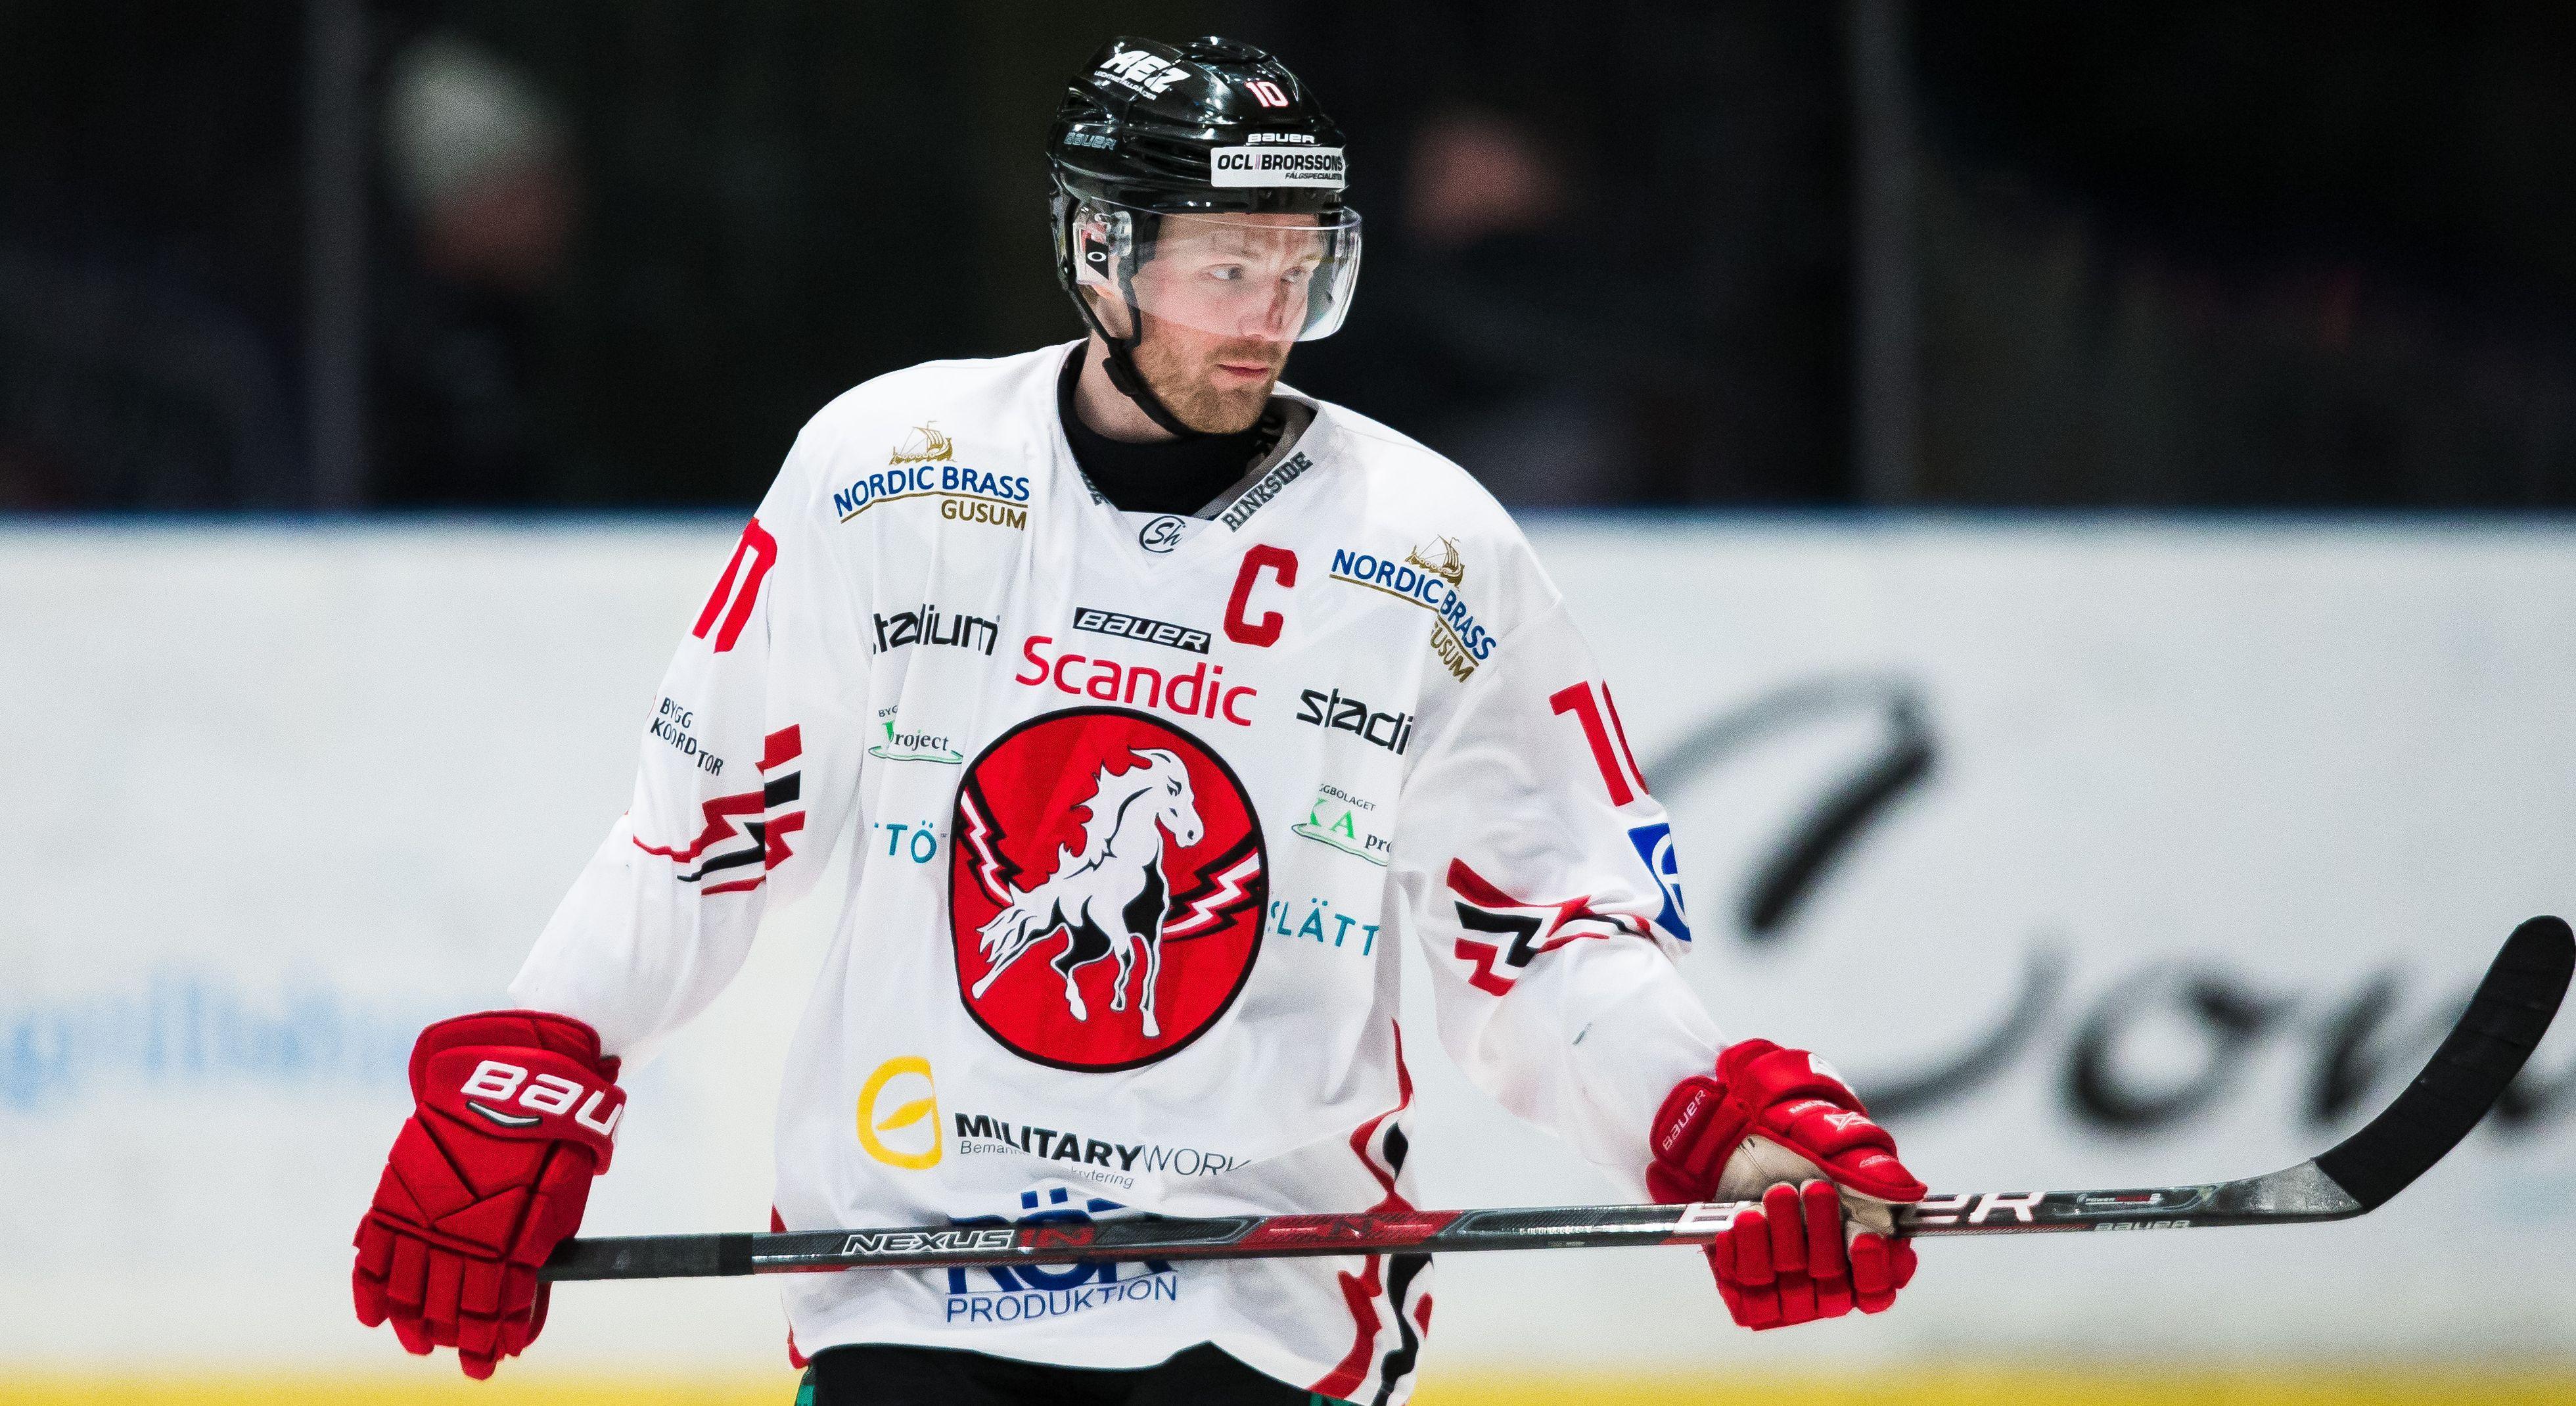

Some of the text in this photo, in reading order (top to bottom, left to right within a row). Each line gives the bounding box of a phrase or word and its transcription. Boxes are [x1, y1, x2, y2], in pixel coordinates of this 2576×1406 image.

[1243, 81, 1289, 107] 10
[1248, 133, 1315, 144] BAUER
[1217, 154, 1343, 172] OCL BRORSSONS
[833, 466, 934, 517] NORDIC
[942, 466, 1030, 502] BRASS
[941, 500, 1027, 531] GUSUM
[1221, 451, 1314, 533] RINKSIDE
[1223, 544, 1299, 648] C
[1331, 548, 1496, 660] NORDIC BRASS
[1076, 611, 1209, 651] BAUER
[1430, 621, 1474, 683] USUM
[1015, 635, 1257, 726] Scandic
[660, 697, 693, 728] BYGG
[1663, 1089, 1706, 1151] BAUER
[841, 1229, 1015, 1255] NEXUS
[946, 1275, 1178, 1323] PRODUKTION
